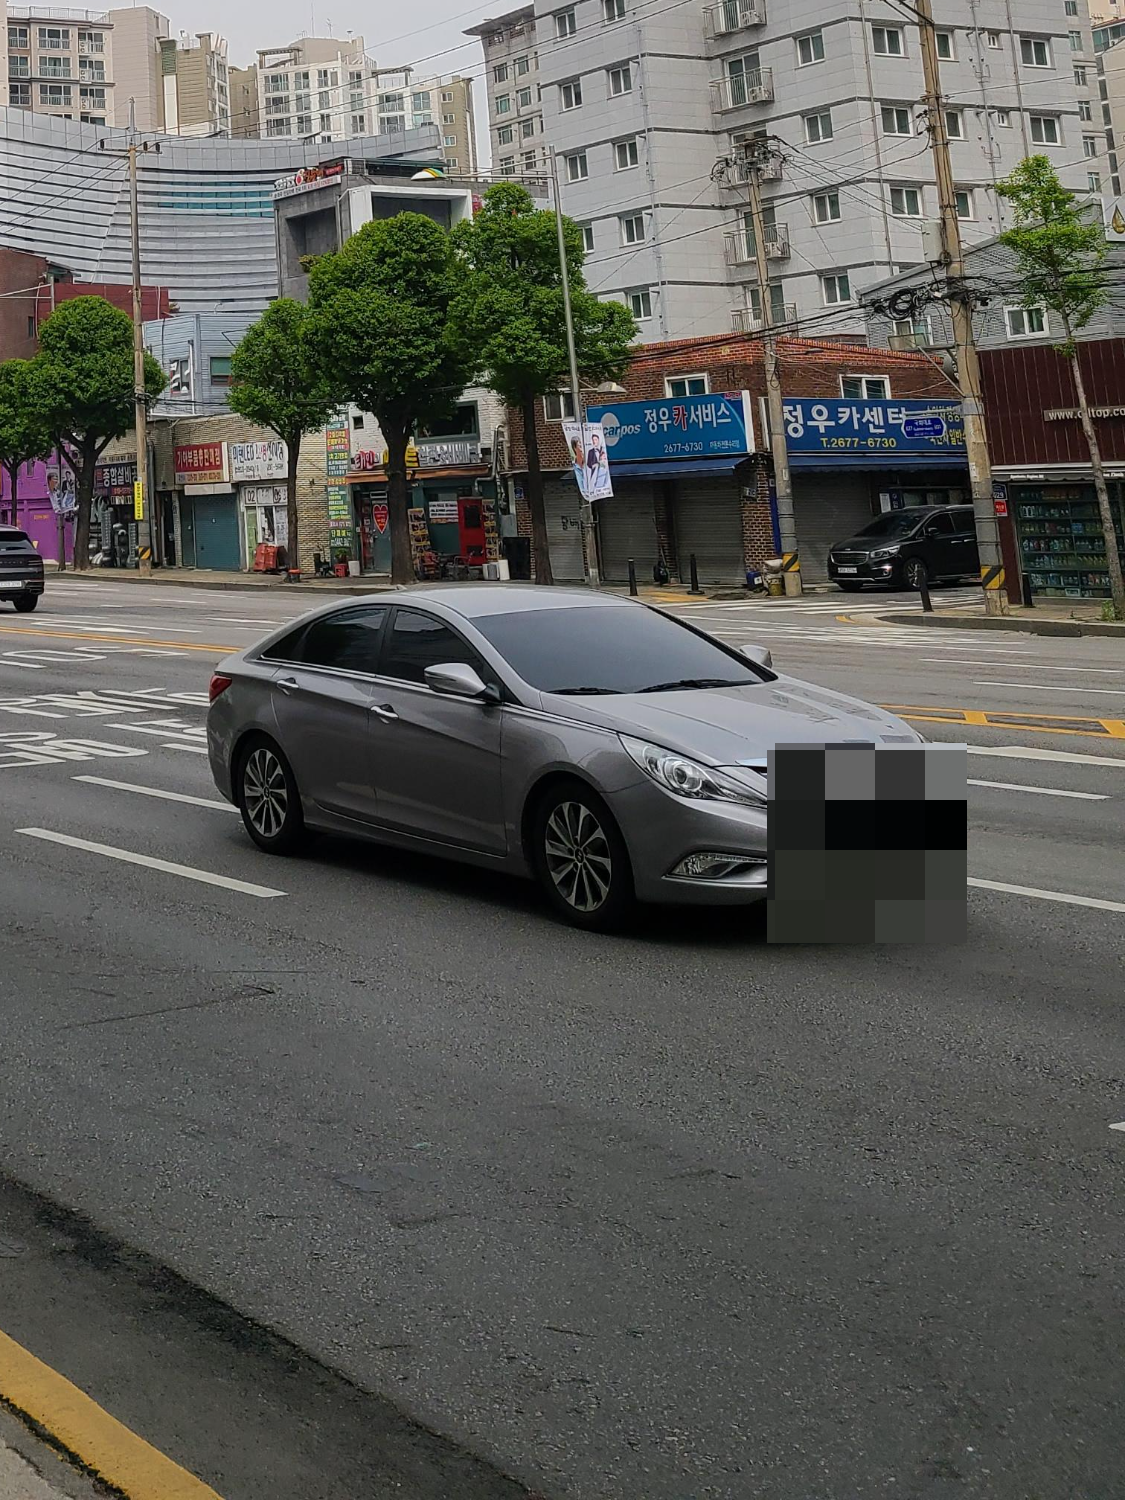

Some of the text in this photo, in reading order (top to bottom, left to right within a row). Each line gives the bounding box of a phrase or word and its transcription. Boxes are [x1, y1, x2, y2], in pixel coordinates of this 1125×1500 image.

[783, 404, 906, 438] 정우카센터
[664, 441, 703, 453] 2677-6730
[820, 437, 897, 448] T.2677-6730
